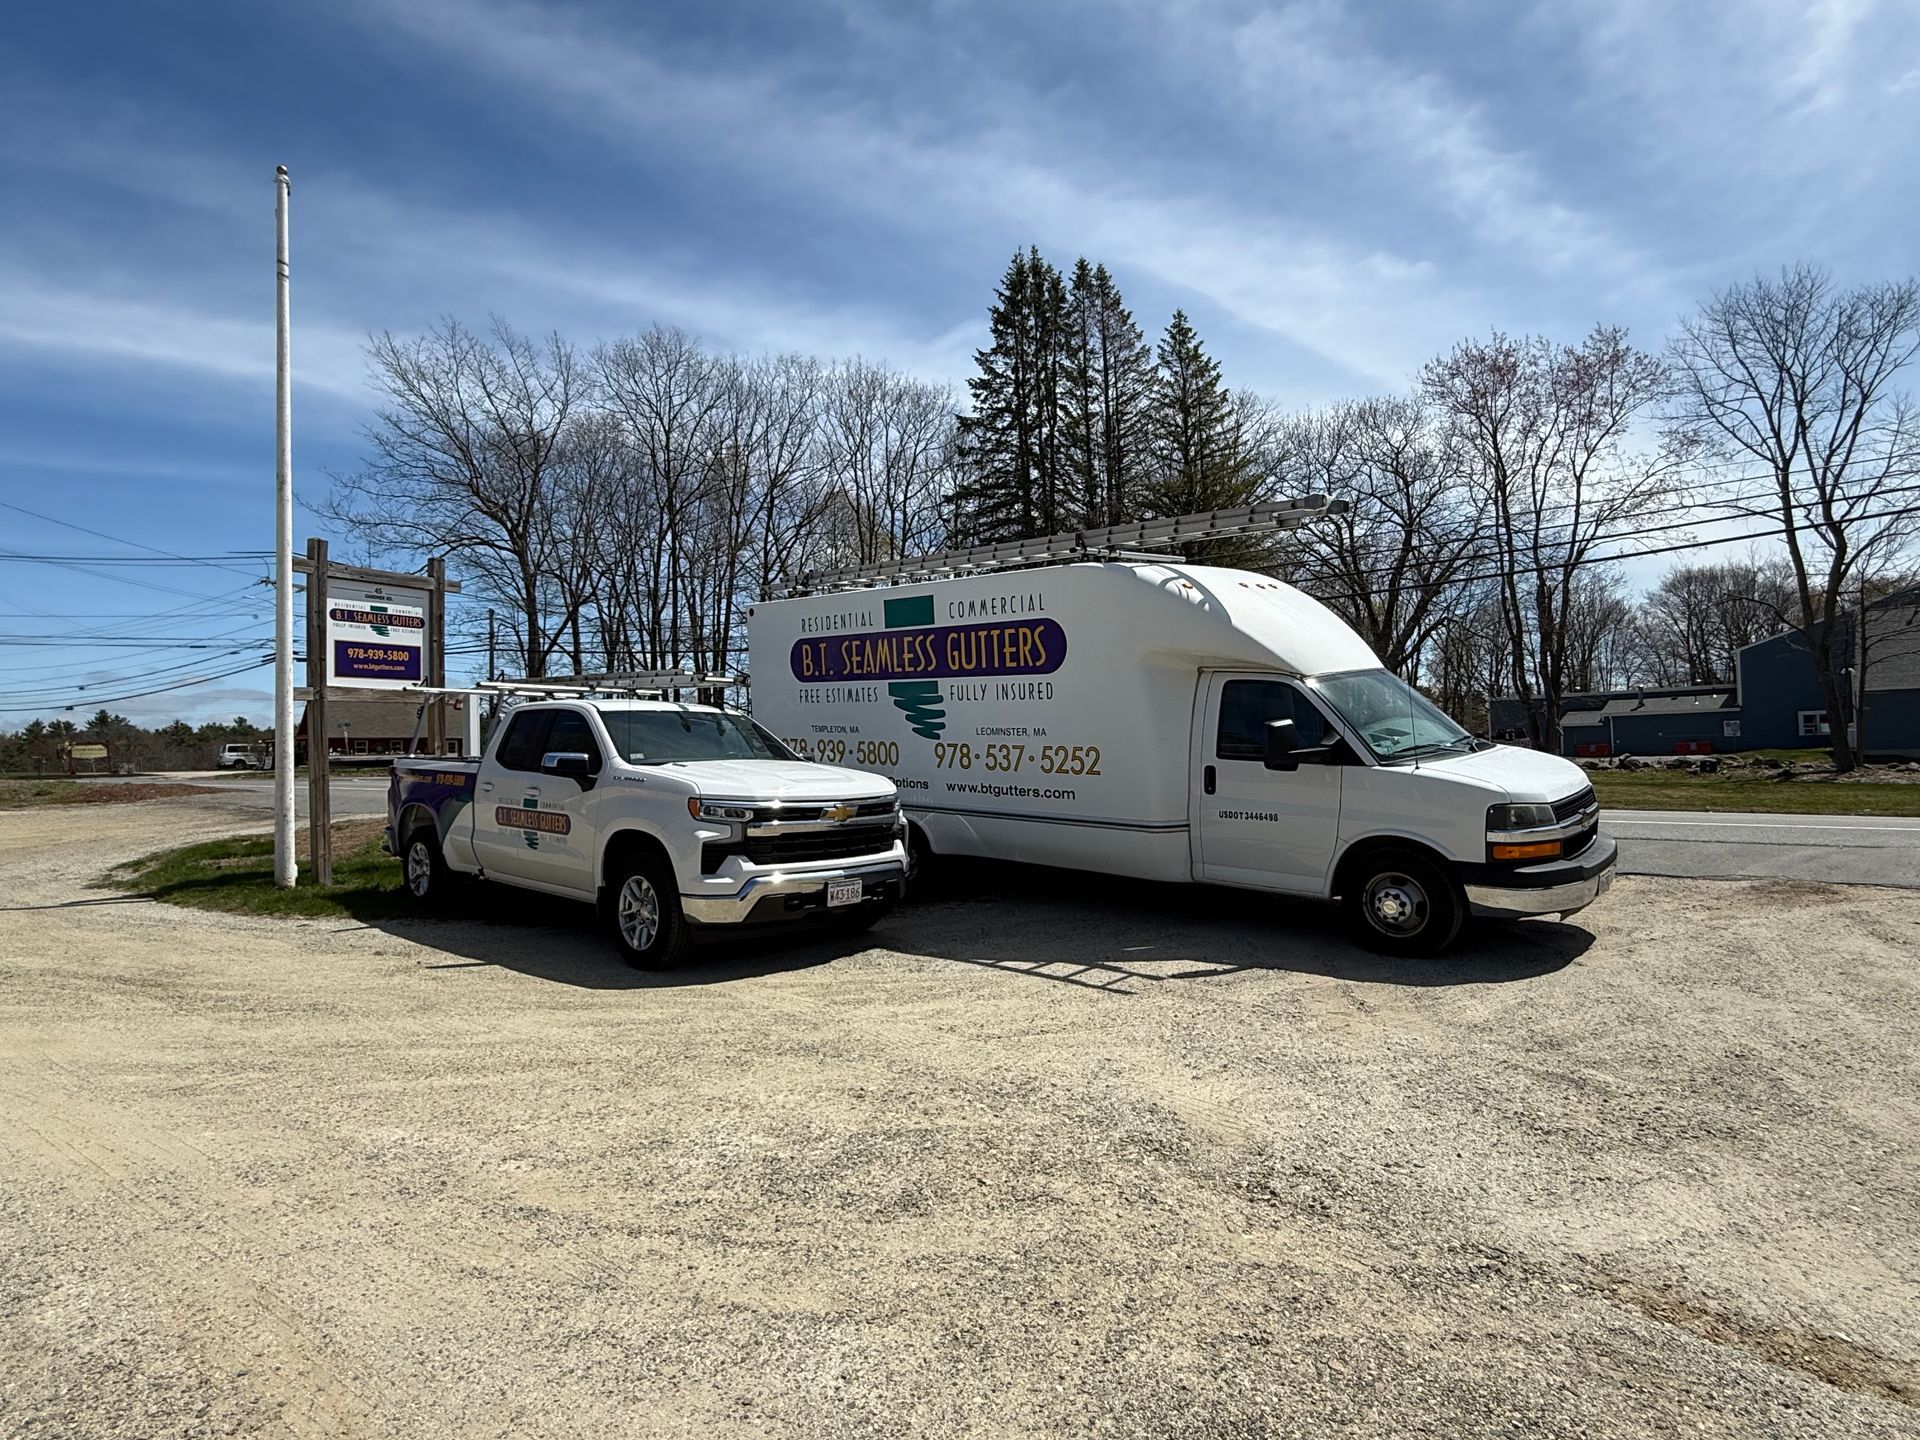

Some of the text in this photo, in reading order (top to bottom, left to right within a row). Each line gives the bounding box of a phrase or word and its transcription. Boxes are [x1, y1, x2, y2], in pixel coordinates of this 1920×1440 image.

[335, 610, 422, 627] B.T. SEAMLESS GUTTERS
[801, 593, 1045, 632] RESIDENTIAL COMMERCIAL
[347, 648, 409, 662] 978-939-5800
[802, 625, 1047, 678] B.T. SEAMLESS GUTTERS
[799, 682, 1054, 704] FREE ESTIMATES FULLY INSURED
[811, 724, 860, 735] TEMPLETON, MA
[975, 726, 1047, 738] LEOMINSTER, MA
[946, 780, 1076, 801] www.btgutters.com
[510, 810, 538, 828] SEAMLESS
[539, 813, 567, 832] GUTTERS
